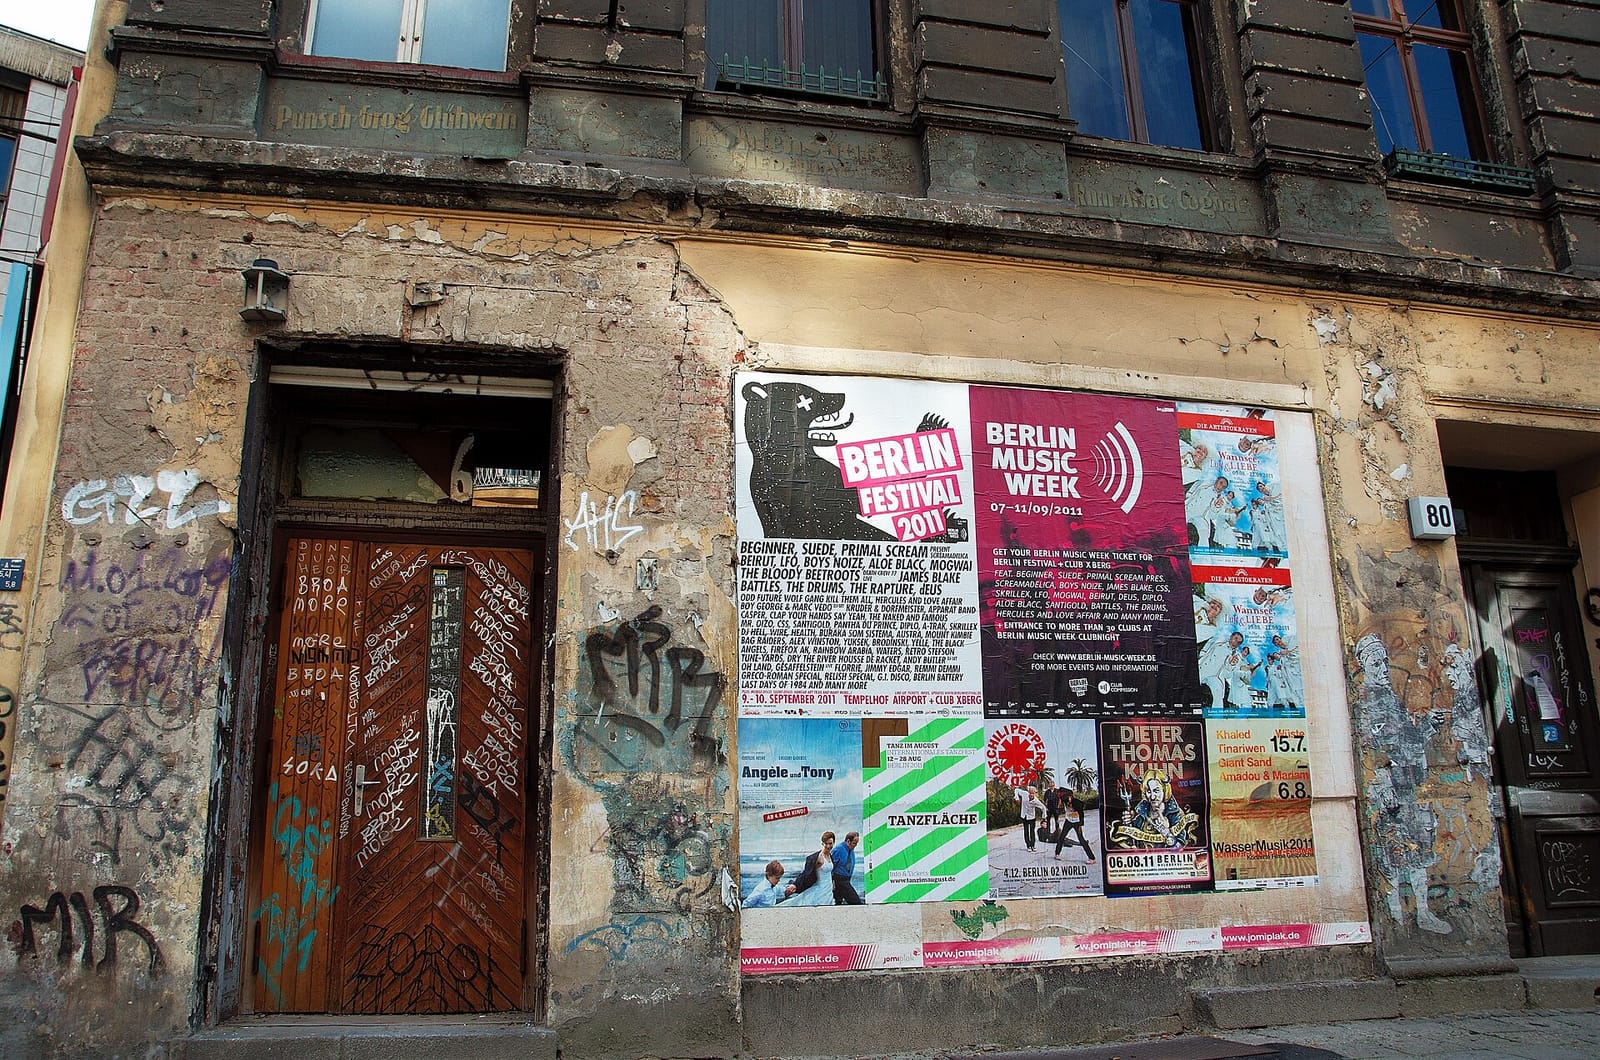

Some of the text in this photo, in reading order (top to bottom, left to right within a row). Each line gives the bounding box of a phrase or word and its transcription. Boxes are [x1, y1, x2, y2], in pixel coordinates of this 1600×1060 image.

[986, 422, 1076, 449] BERLIN
[840, 431, 958, 483] BERLIN
[992, 448, 1078, 474] MUSIC
[1004, 473, 1081, 498] WEEK
[860, 478, 960, 514] FESTIVAL
[1426, 504, 1451, 527] 80
[897, 508, 944, 542] 2011
[741, 542, 798, 556] BEGINNER,
[802, 543, 837, 557] SUEDE,
[842, 544, 882, 556] PRIMAL
[886, 545, 928, 558] SCREAM
[741, 556, 972, 572] BEIRUT, LFO, BOYS NOIZE, ALOE BLACC, MOGWAI
[741, 568, 759, 579] THE
[762, 568, 802, 580] BLOODY
[806, 569, 860, 581] BEETROOTS
[898, 572, 929, 583] JAMES
[932, 572, 960, 583] BLAKE
[1016, 571, 1054, 579] BEGINNER,
[1058, 572, 1084, 580] SUEDE,
[741, 581, 942, 596] BATTLES, THE DRUMS, THE RAPTURE, dEUS
[756, 695, 767, 704] 10.
[770, 695, 814, 704] SEPTEMBER
[818, 695, 836, 704] 2011
[844, 695, 889, 704] TEMPELHOF
[893, 696, 927, 704] AIRPORT
[936, 696, 954, 704] CLUB
[957, 696, 982, 704] XBERG
[1120, 725, 1184, 743] DIETER
[1216, 730, 1251, 739] Khaled
[1218, 744, 1265, 753] Tinariwen
[1270, 736, 1307, 752] 15.7.
[1110, 744, 1196, 762] THOMAS
[1218, 756, 1272, 767] Giant Sand
[742, 766, 788, 780] Angèle
[801, 766, 834, 780] Tony
[1220, 771, 1308, 781] Amadou & Mariam
[1278, 782, 1311, 799] 6.8.
[888, 812, 977, 826] TANZFLÄCHE
[1213, 838, 1313, 853] WasserMusik2011
[1109, 854, 1192, 868] 06.08.11 BERLIN
[1004, 868, 1021, 878] 4.12.
[1022, 867, 1048, 878] BERLIN
[1061, 866, 1087, 876] WORLD
[1221, 931, 1300, 943] www.jomiplak.de
[741, 954, 839, 966] www.jomiplak.de
